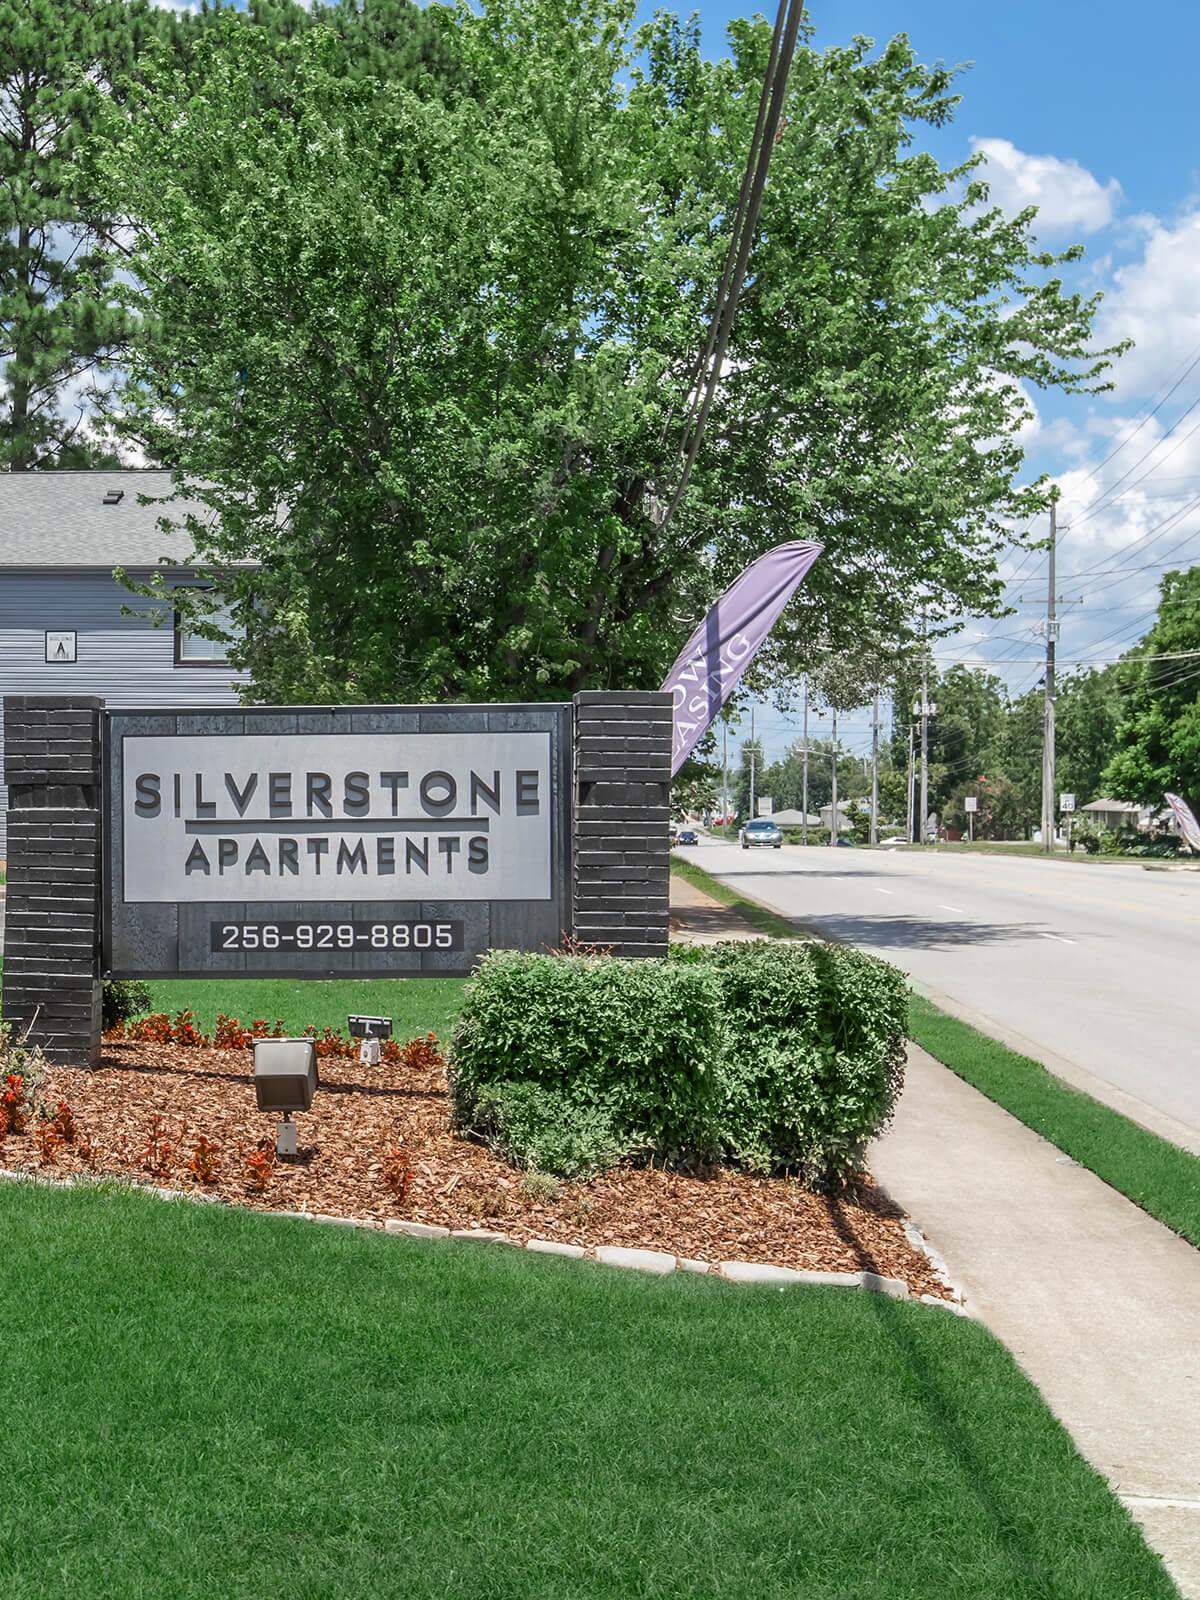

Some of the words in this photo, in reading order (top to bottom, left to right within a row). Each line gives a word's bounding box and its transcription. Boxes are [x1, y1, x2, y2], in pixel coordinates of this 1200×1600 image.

[671, 646, 708, 711] OW
[673, 633, 750, 757] ASING
[135, 770, 540, 818] SILVERSTONE
[185, 836, 489, 876] APARTMENTS
[222, 924, 453, 949] 256-929-8805
